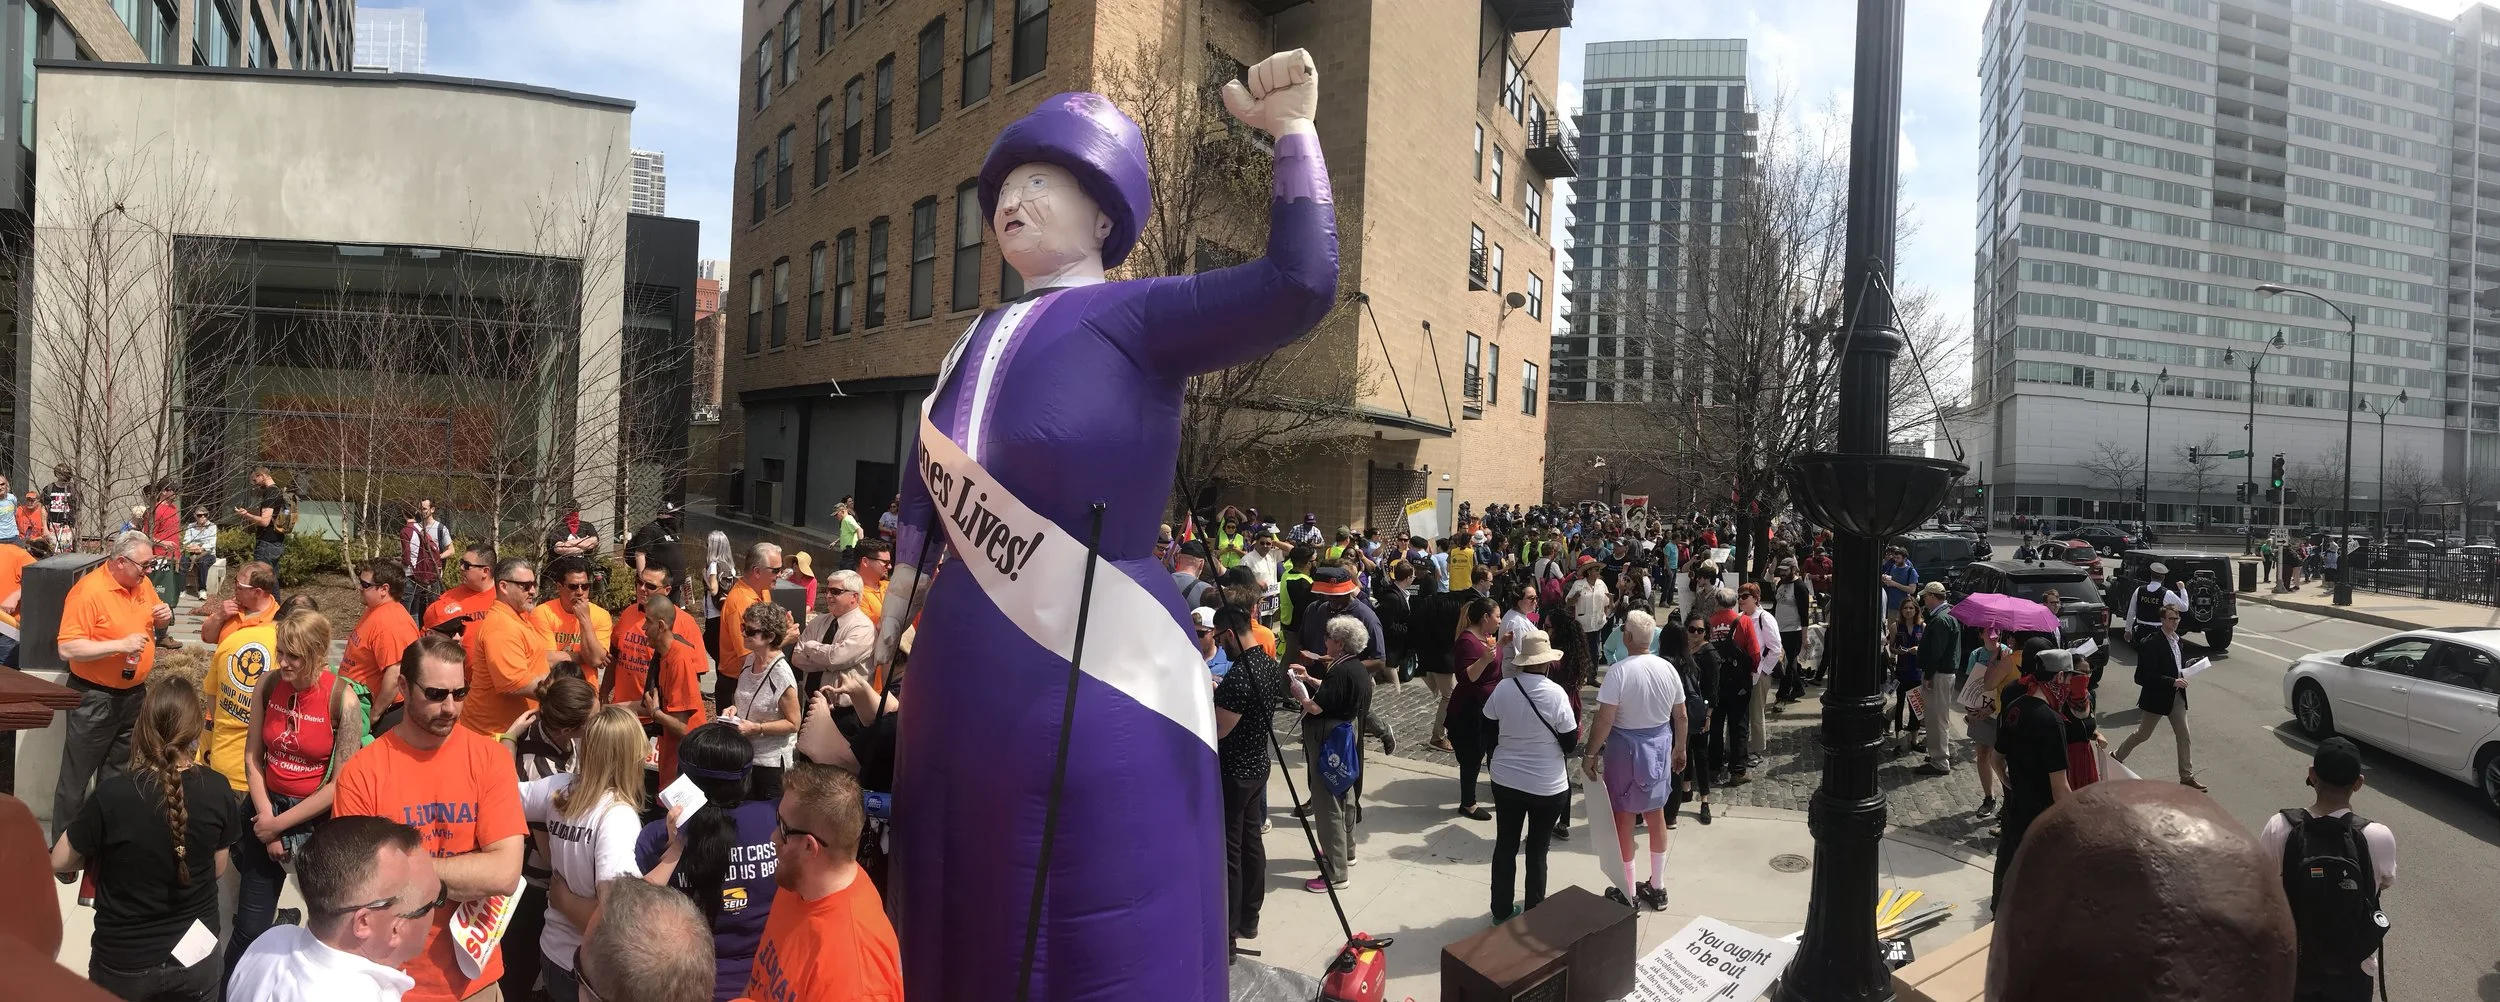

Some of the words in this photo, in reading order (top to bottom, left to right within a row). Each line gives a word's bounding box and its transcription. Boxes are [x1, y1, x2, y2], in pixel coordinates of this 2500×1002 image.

[918, 438, 954, 508] nes
[950, 475, 1045, 582] Lives!
[2141, 595, 2160, 604] POLICE
[624, 631, 650, 647] LiUN
[624, 663, 648, 674] ILLINOI
[238, 693, 252, 708] UNI
[303, 714, 325, 723] District
[279, 761, 325, 773] CHAMPIONS
[403, 802, 479, 828] LiUNA!
[746, 841, 777, 862] CASS
[740, 864, 756, 880] US
[723, 898, 748, 909] SEIU
[465, 894, 506, 960] SUMM
[1654, 956, 1682, 981] revolution
[1685, 941, 1702, 956] to
[1697, 949, 1720, 967] be
[1718, 961, 1748, 980] out
[1649, 964, 1662, 975] ask
[1658, 971, 1669, 981] for
[1666, 978, 1686, 996] bonds
[1639, 983, 1656, 999] went
